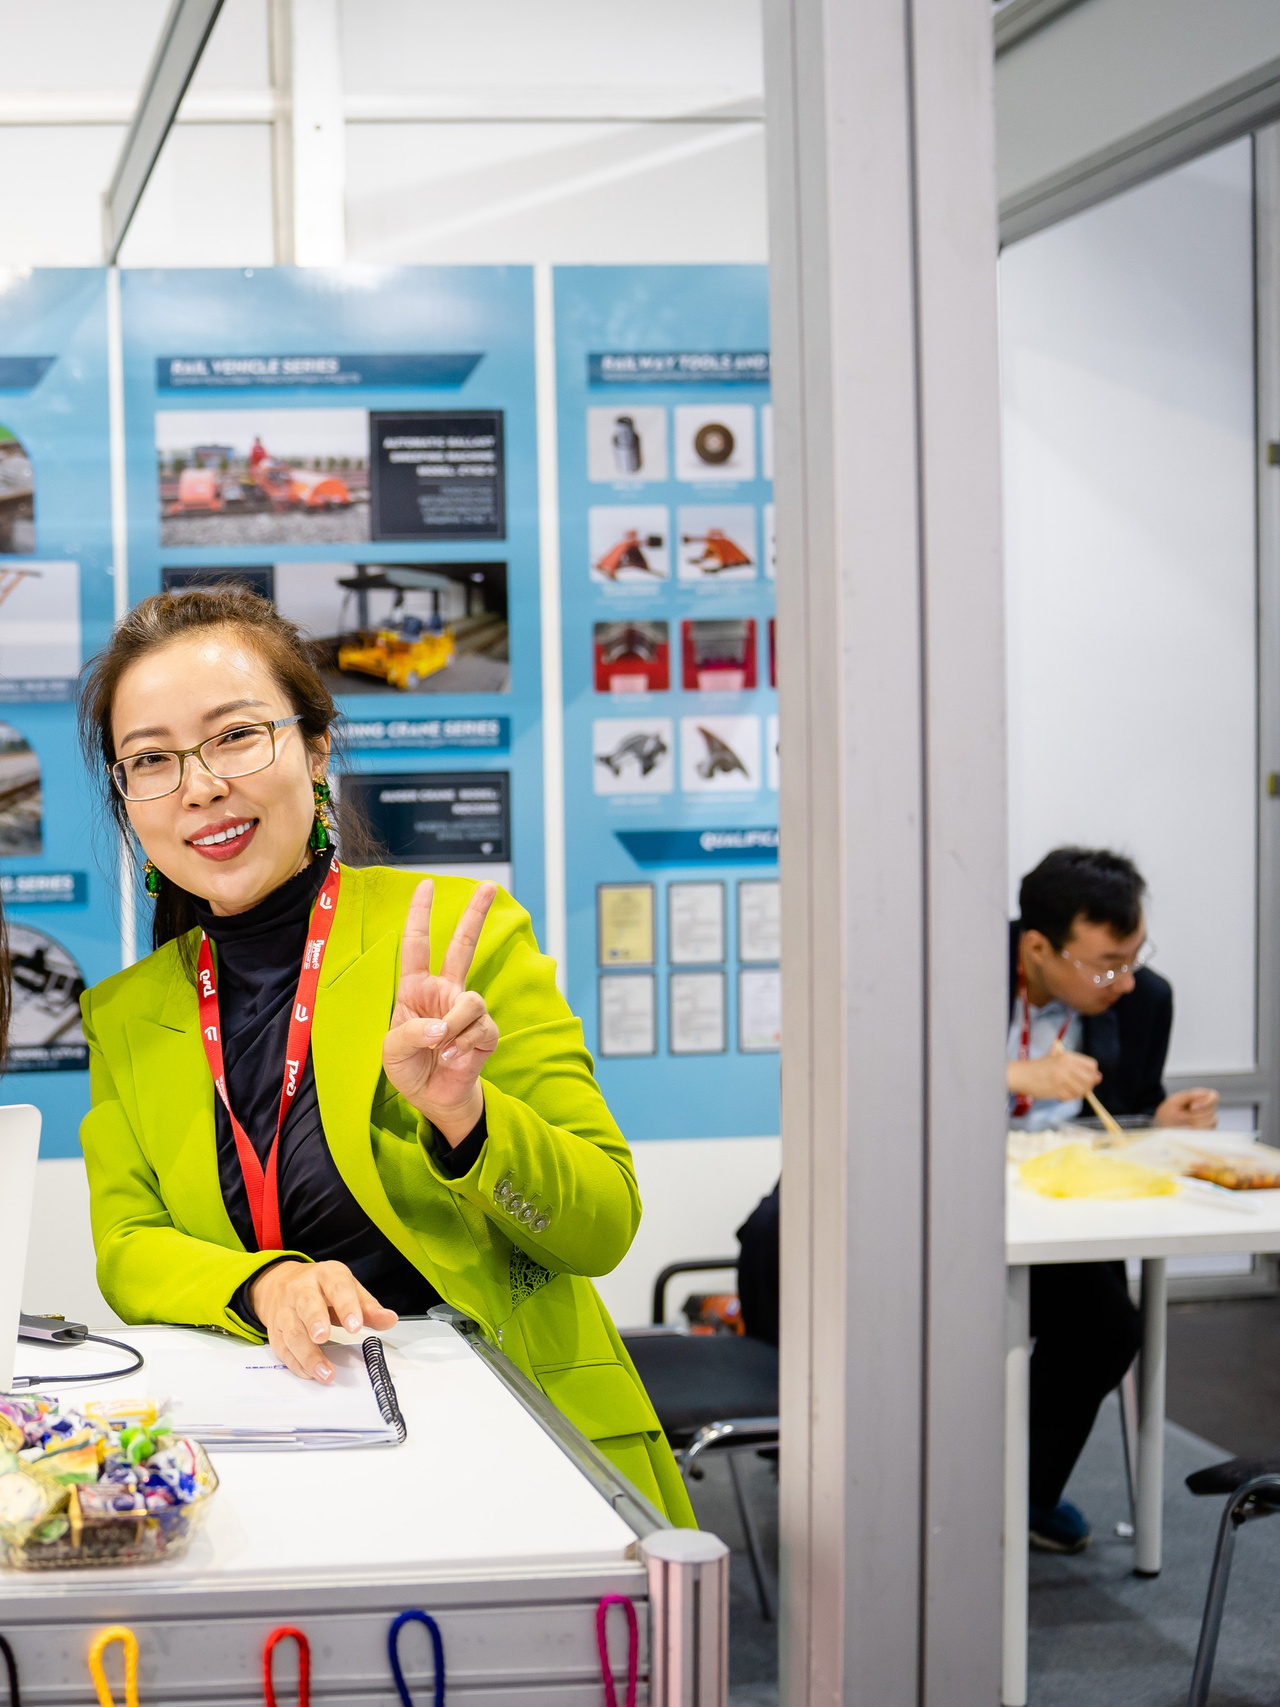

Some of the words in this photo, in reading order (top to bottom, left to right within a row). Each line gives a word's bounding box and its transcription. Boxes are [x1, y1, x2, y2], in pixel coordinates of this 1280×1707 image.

[282, 357, 340, 374] SERIES
[443, 719, 500, 737] SERIES
[16, 874, 74, 892] SERIES
